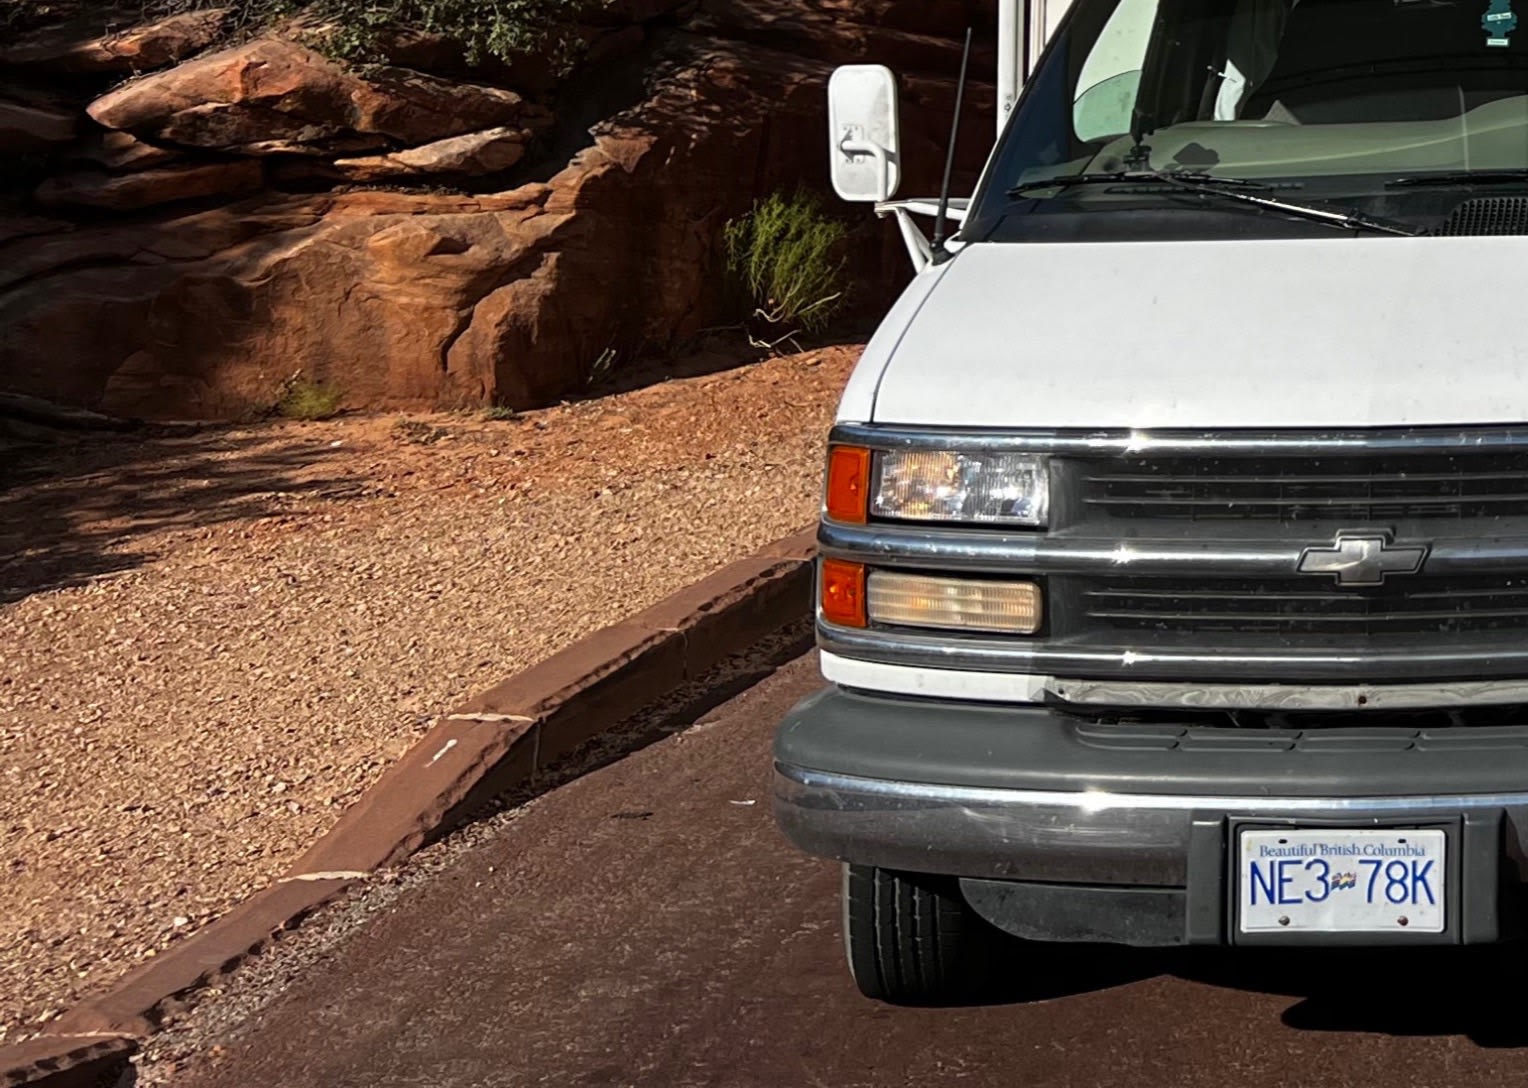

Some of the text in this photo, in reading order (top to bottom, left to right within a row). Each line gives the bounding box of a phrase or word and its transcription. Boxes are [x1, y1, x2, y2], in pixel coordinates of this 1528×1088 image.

[1259, 844, 1426, 857] Beautiful British Columbia
[1250, 858, 1435, 905] NE3 78K
